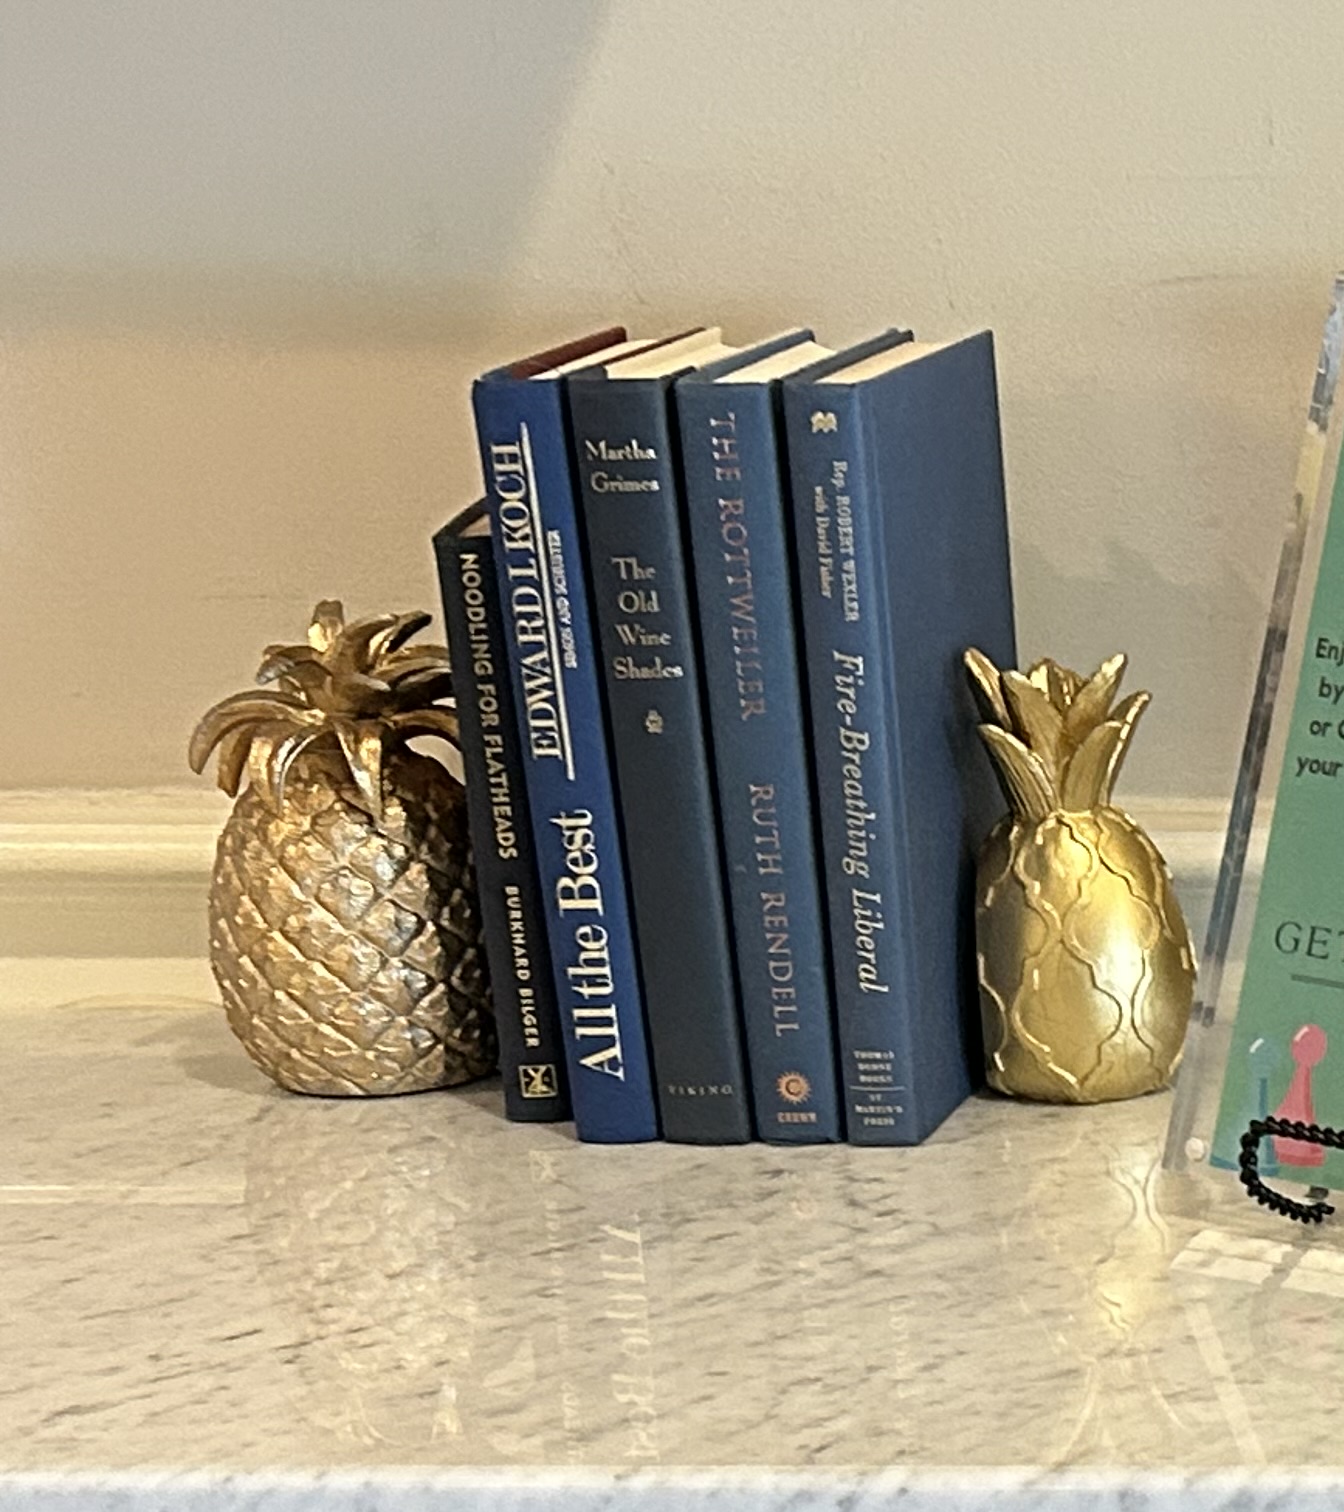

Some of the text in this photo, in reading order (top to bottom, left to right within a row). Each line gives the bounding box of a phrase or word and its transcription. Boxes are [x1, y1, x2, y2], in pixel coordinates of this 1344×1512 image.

[585, 439, 657, 461] Martha
[590, 472, 660, 493] Grimes
[611, 557, 655, 580] The
[710, 412, 767, 722] THE ROTTWEILER
[491, 441, 562, 761] EDWARD KOCH
[618, 591, 661, 614] Old
[616, 624, 672, 646] Wine
[613, 656, 684, 679] Shades
[459, 553, 518, 860] NOODLING FOR FLATHEADS
[1309, 720, 1332, 737] or
[1295, 755, 1344, 778] your
[832, 650, 889, 994] Fire-Breathing Liberal
[748, 783, 799, 1038] RUTH RENDELL
[505, 886, 532, 980] BURKHARD
[549, 809, 625, 1082] All the Best
